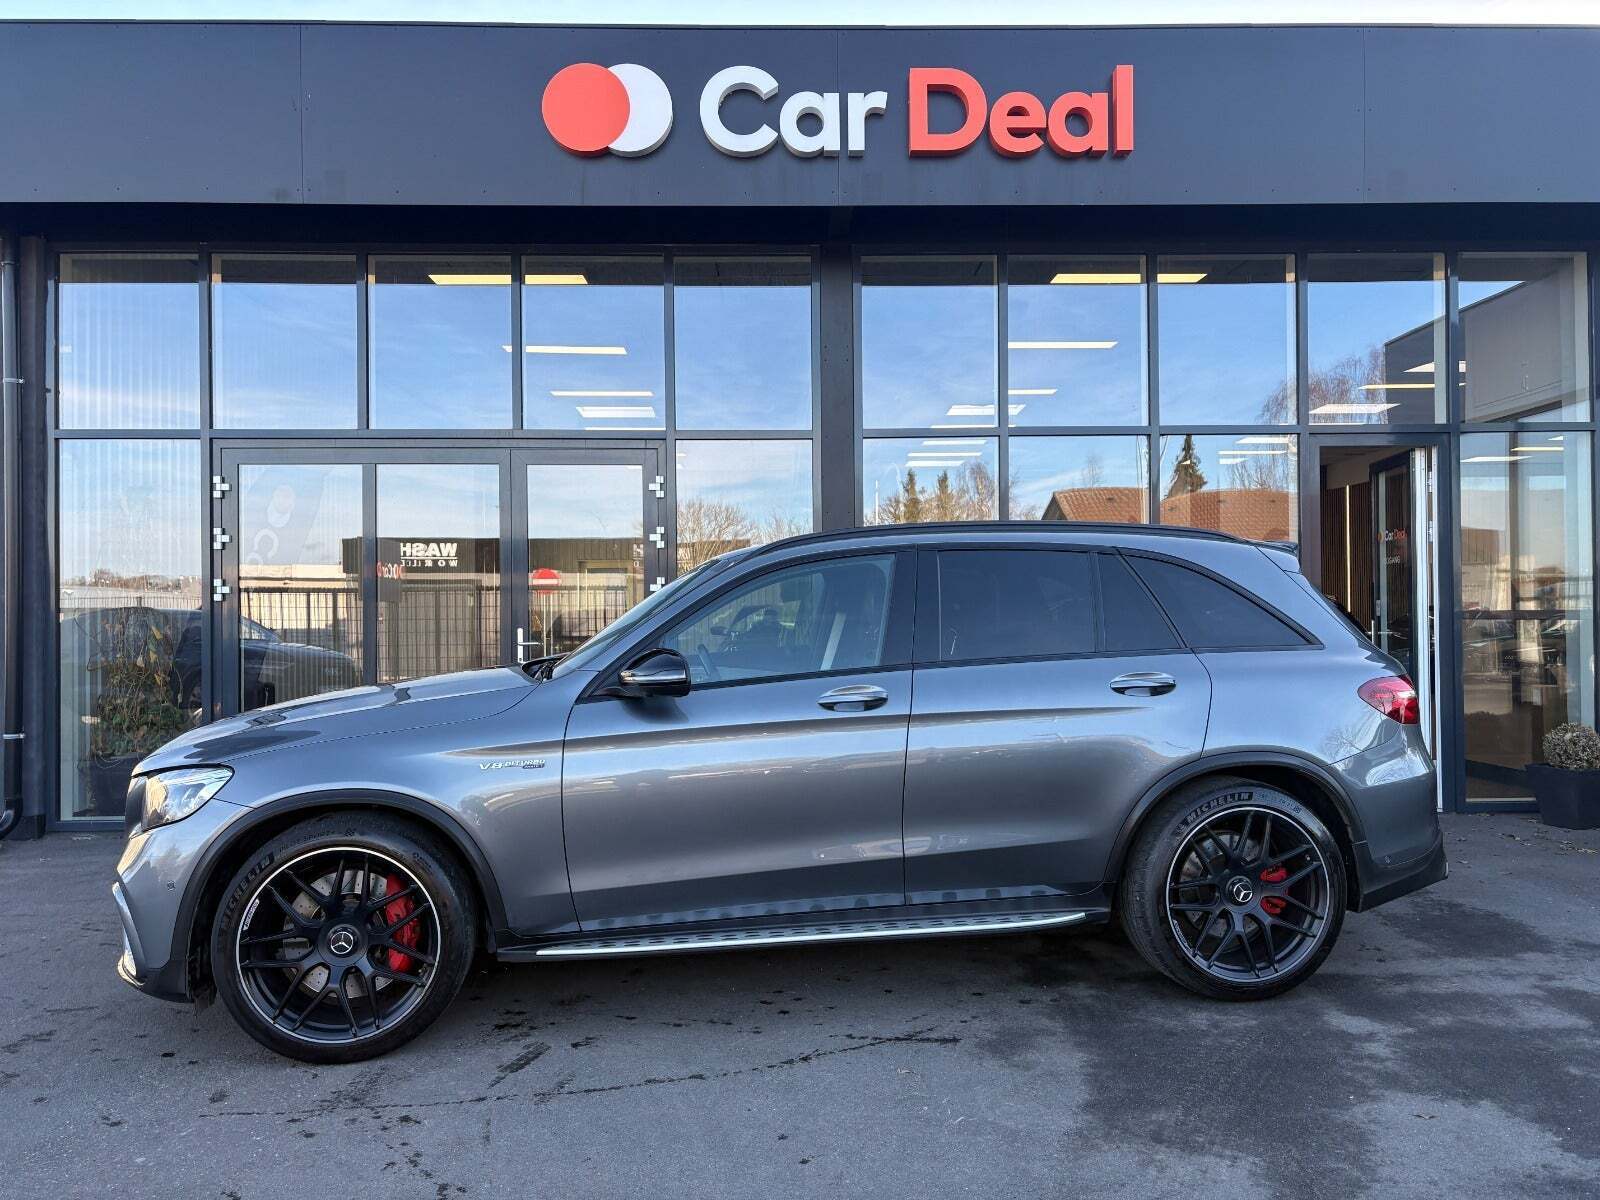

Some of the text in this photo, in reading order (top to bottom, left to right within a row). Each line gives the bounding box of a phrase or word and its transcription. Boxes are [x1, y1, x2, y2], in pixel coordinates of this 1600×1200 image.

[700, 64, 1134, 158] Car Deal
[480, 762, 503, 770] V8
[1187, 791, 1250, 823] MICHELIN
